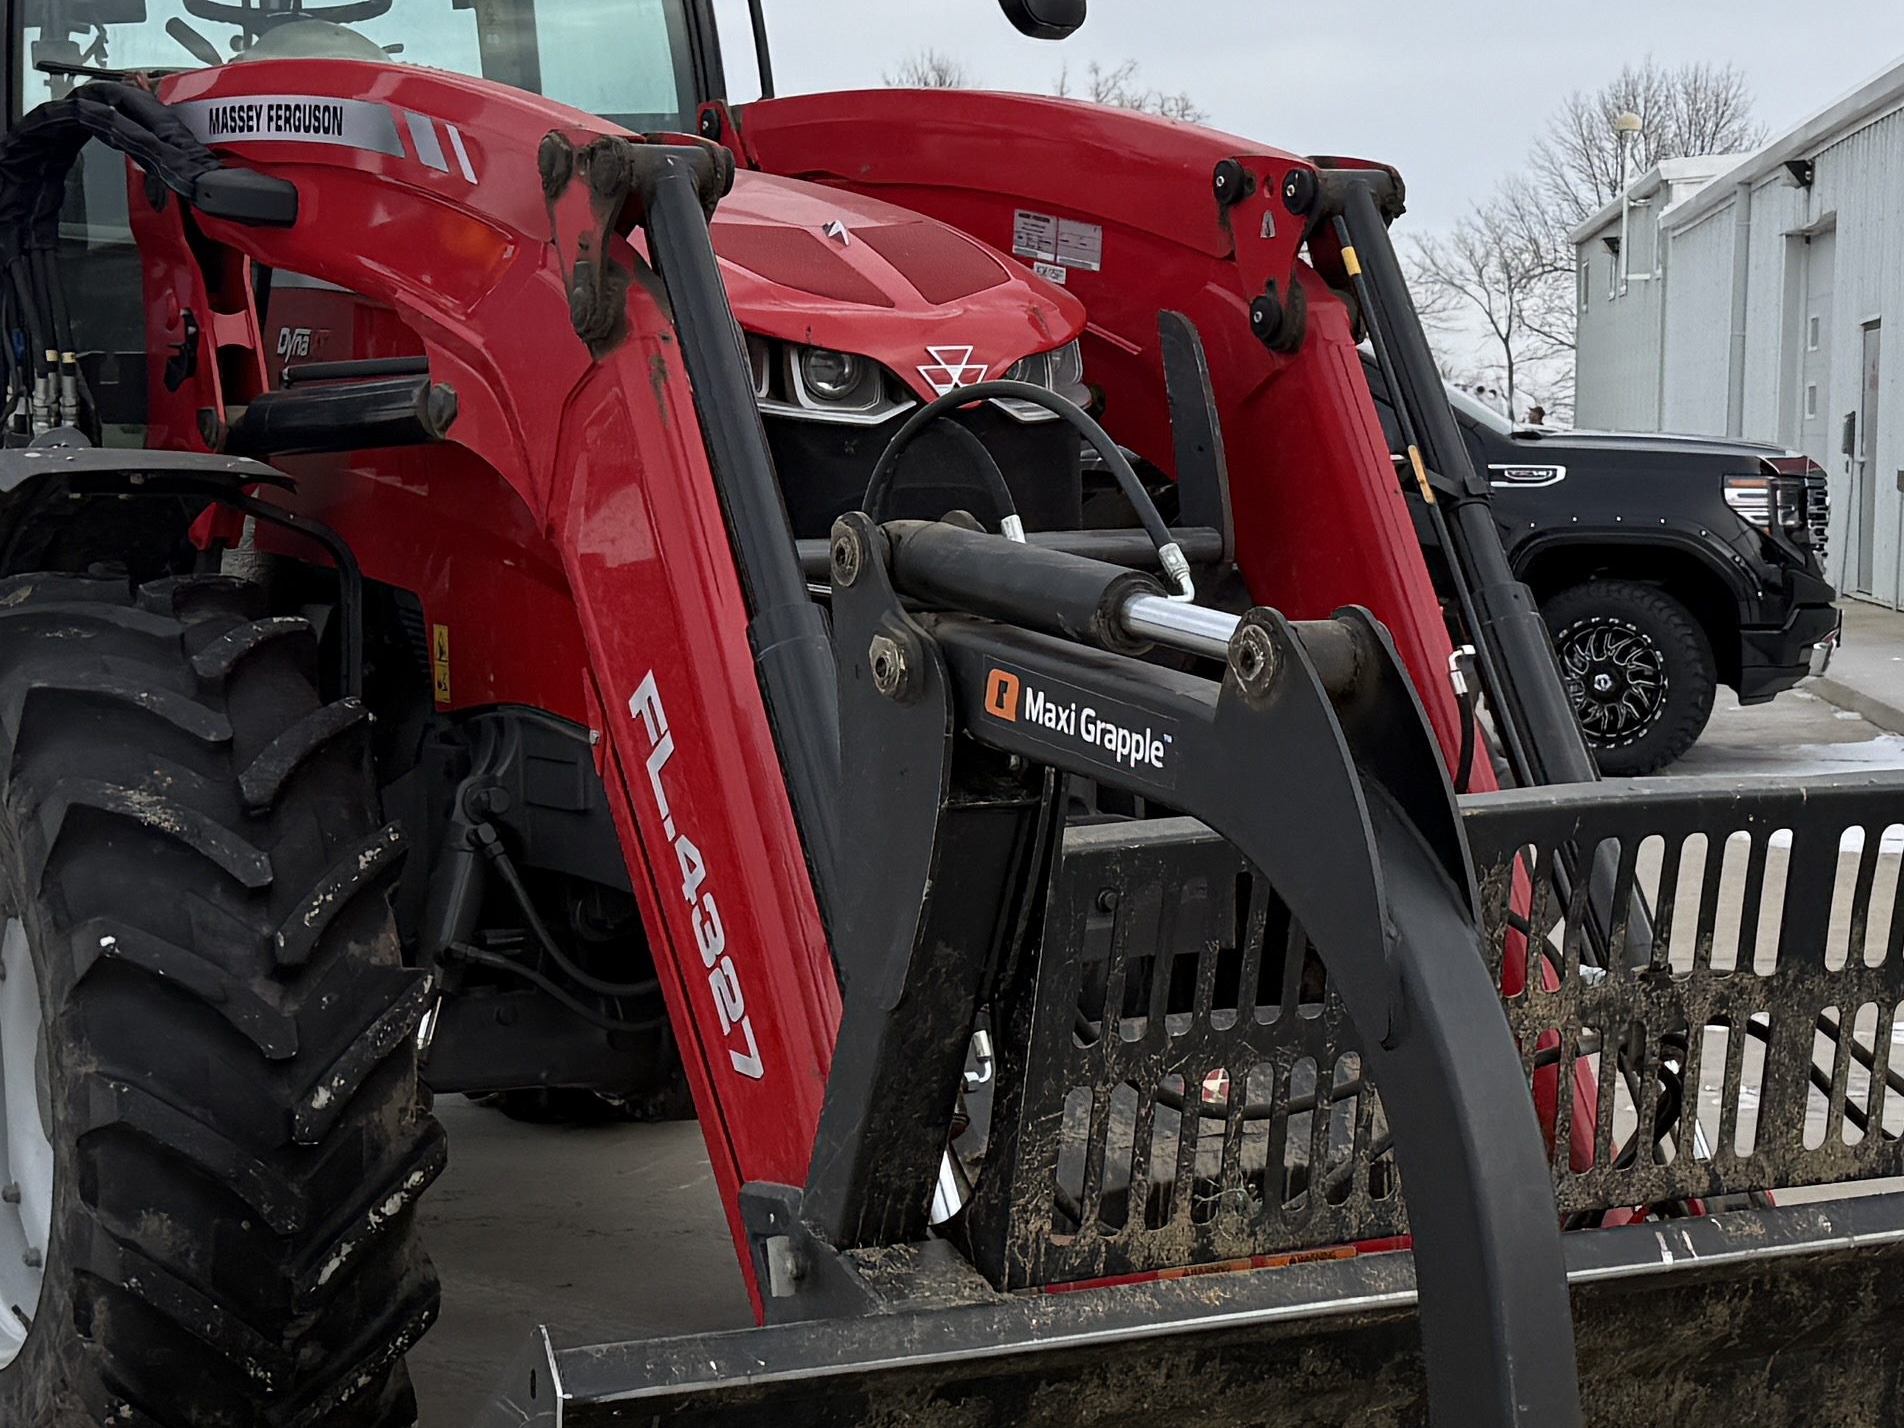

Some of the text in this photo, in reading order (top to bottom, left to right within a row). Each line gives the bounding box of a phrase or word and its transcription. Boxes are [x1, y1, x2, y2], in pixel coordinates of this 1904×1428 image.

[209, 104, 343, 136] MASSEY FERGUSON
[1025, 687, 1076, 736] Maxi
